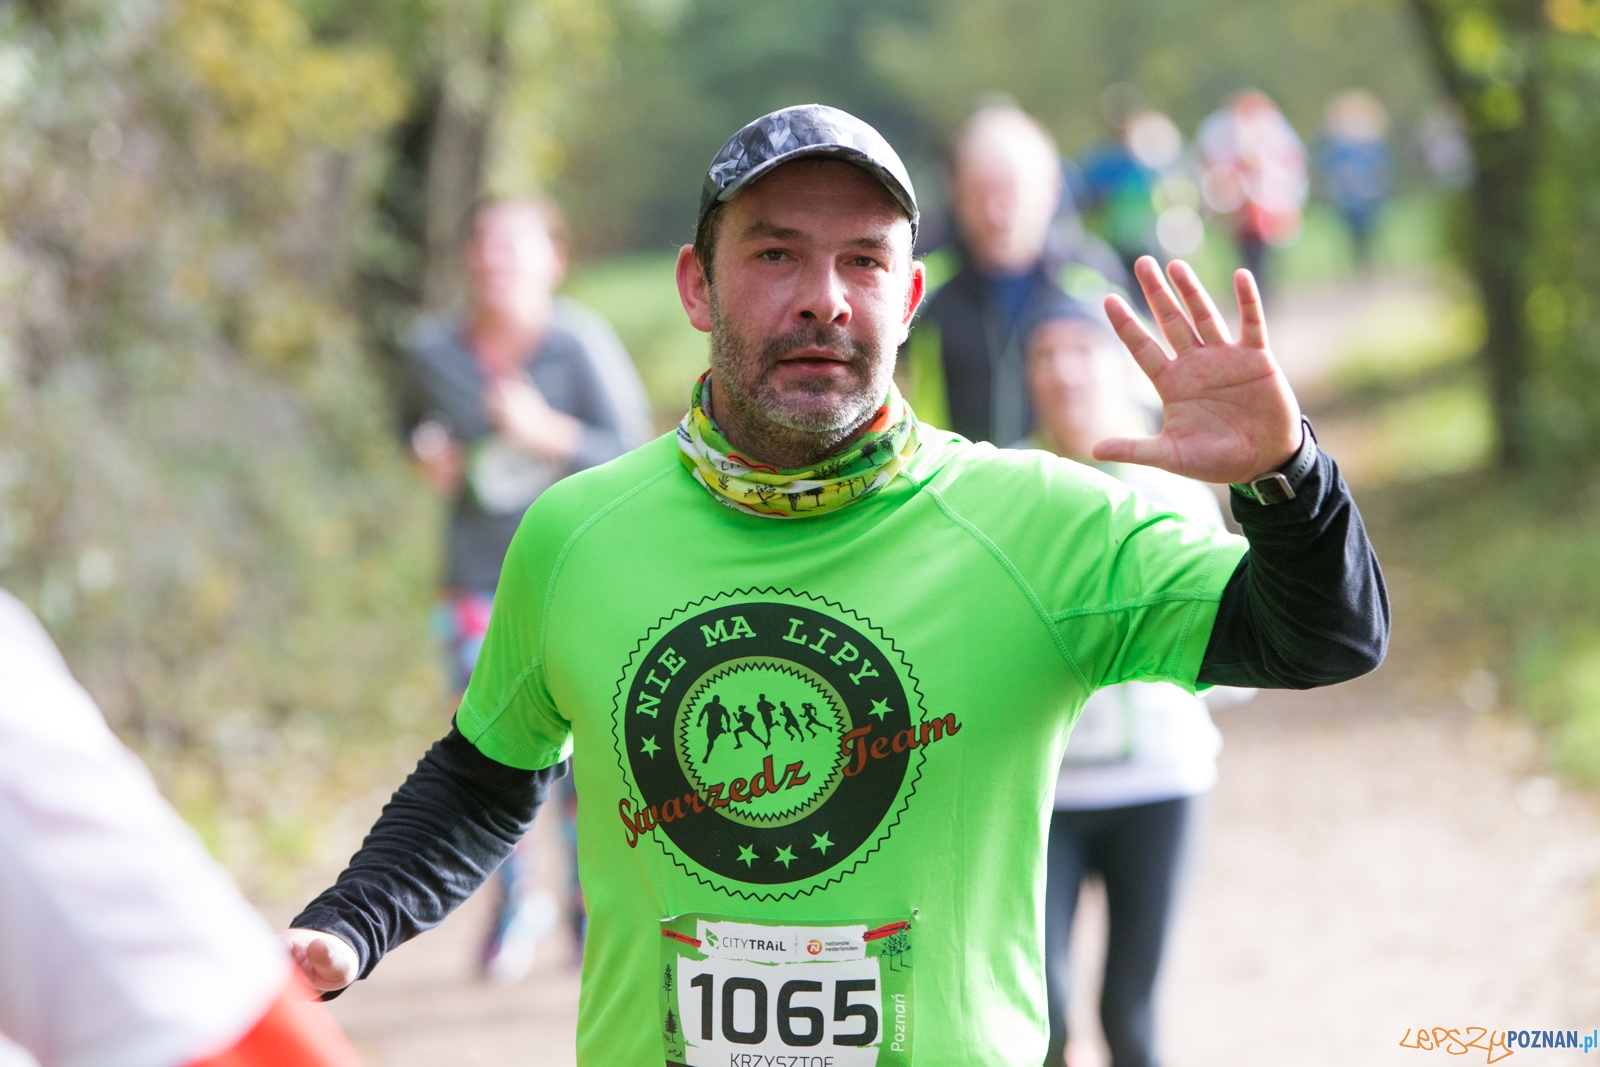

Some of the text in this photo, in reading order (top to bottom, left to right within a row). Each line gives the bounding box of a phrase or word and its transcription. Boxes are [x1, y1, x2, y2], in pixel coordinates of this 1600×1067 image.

[636, 615, 880, 718] NIE MA LIPY
[618, 713, 962, 848] Swarzędz Team
[690, 973, 879, 1047] 1065
[890, 993, 906, 1053] Poznań
